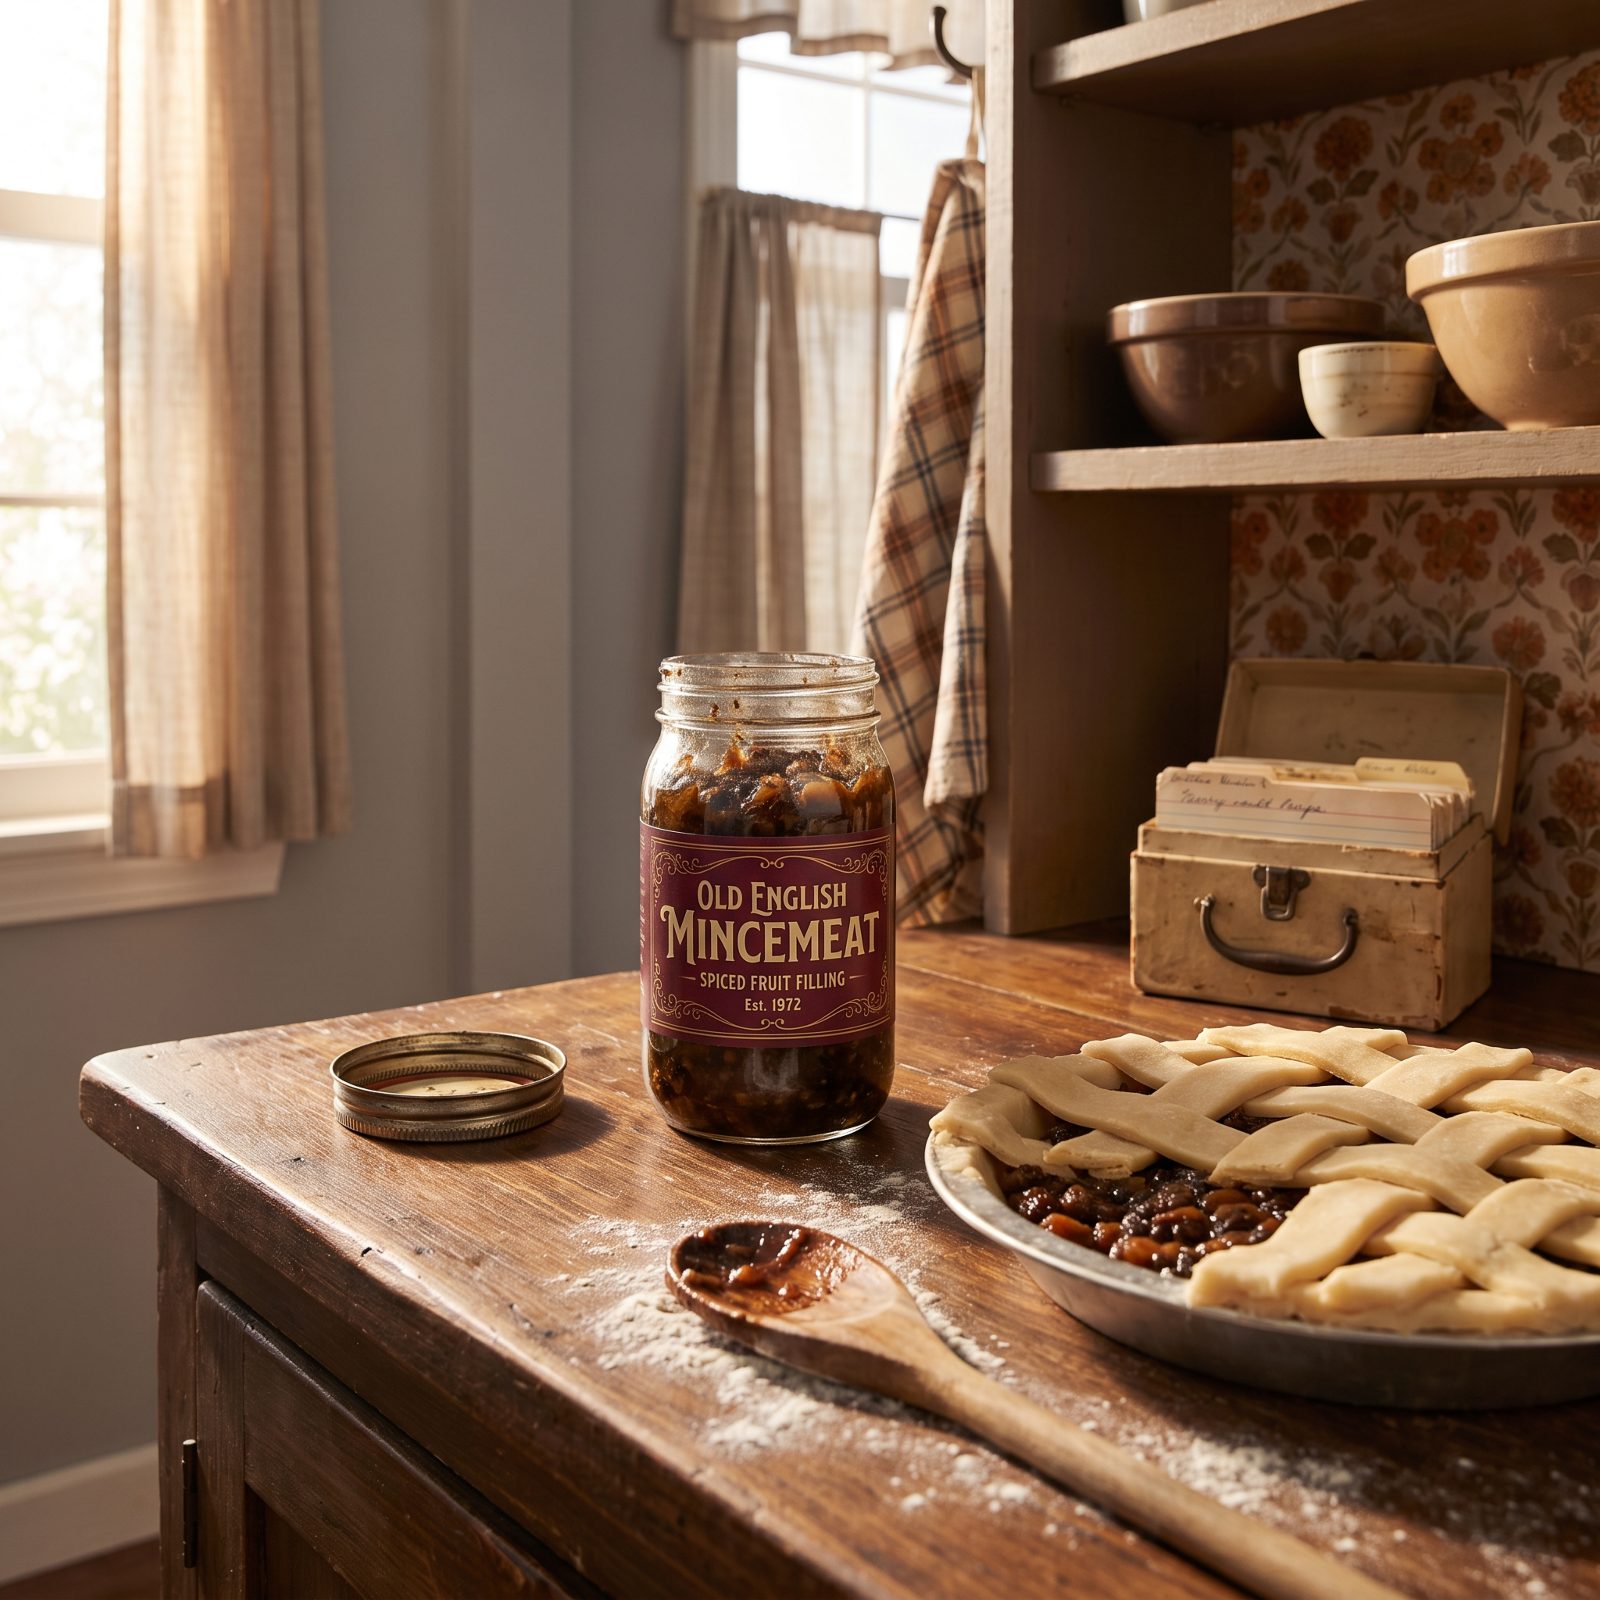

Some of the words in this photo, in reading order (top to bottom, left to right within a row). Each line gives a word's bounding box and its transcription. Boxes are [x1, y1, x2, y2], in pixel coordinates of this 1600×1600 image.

[697, 880, 743, 911] OLD
[750, 881, 847, 917] ENGLISH
[660, 904, 880, 966] MINCEMEAT
[700, 971, 746, 990] SPICED
[750, 974, 792, 991] FRUIT
[796, 970, 846, 990] FILLING
[744, 998, 767, 1012] Est.
[772, 997, 802, 1012] 1972
